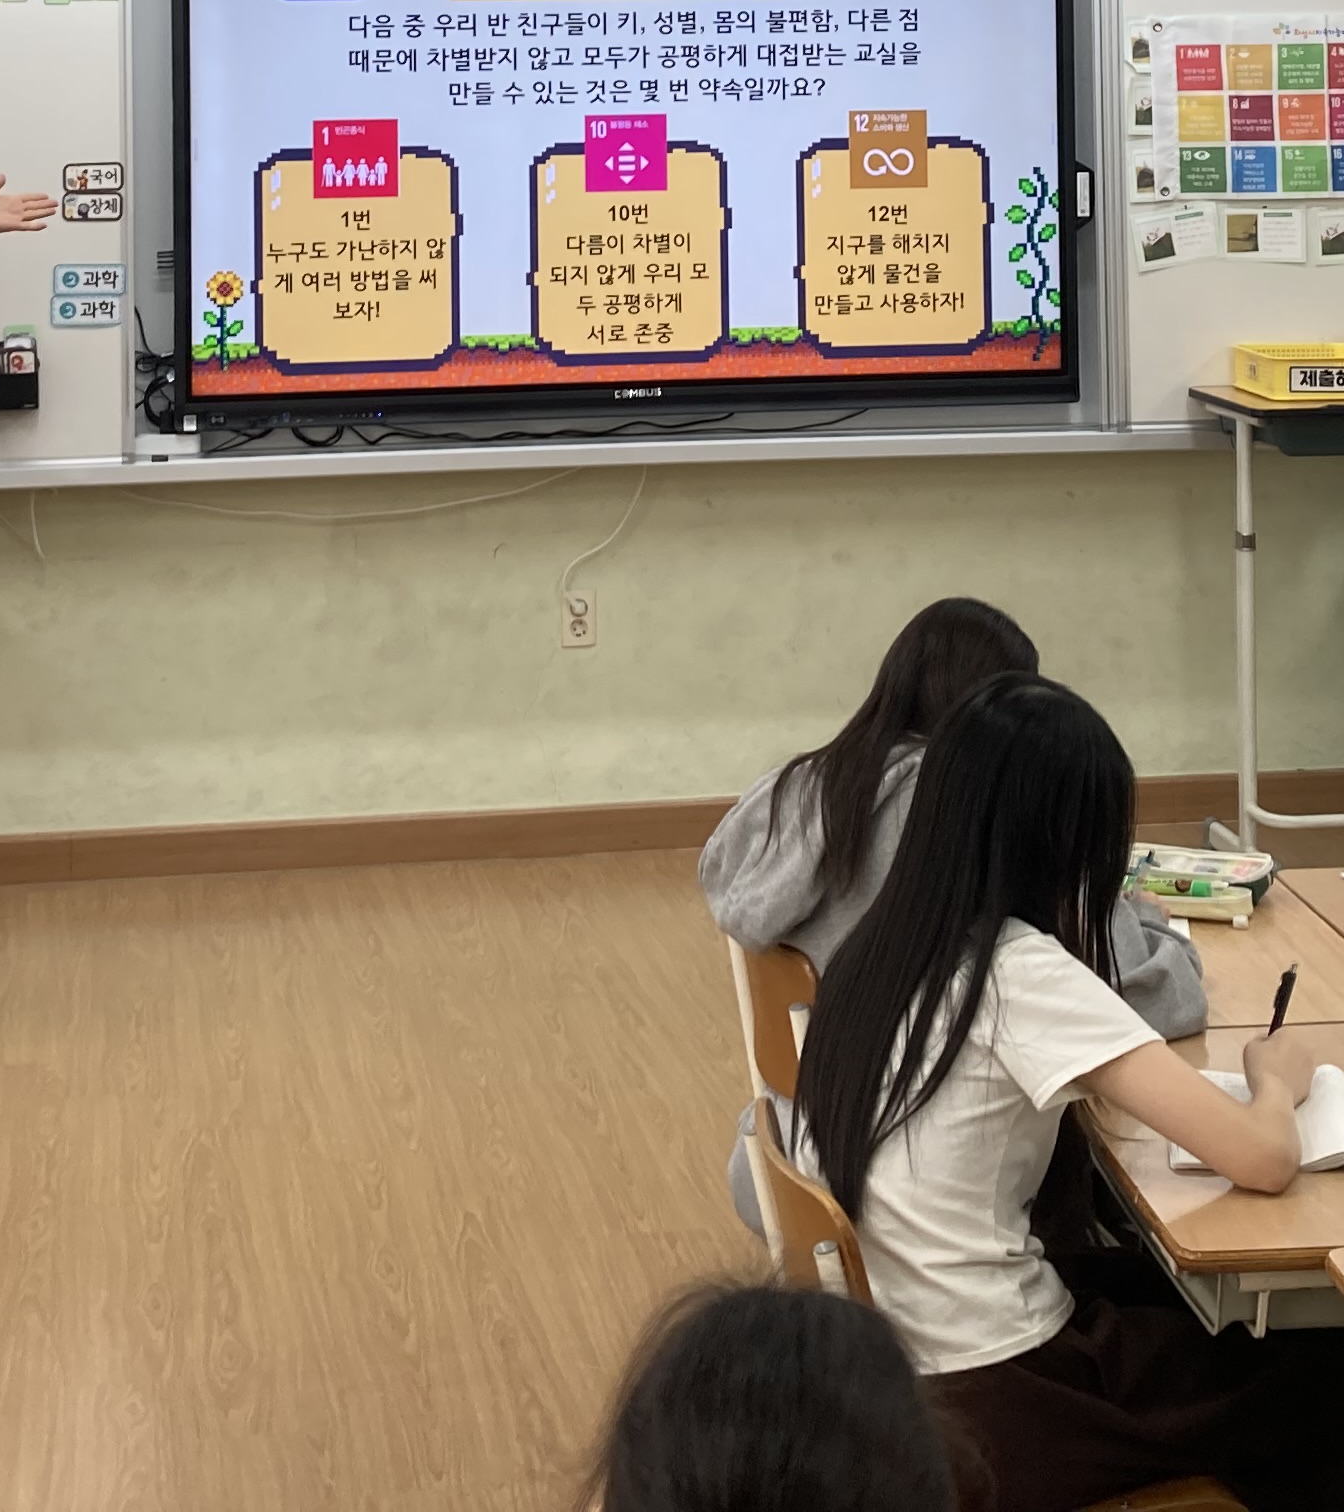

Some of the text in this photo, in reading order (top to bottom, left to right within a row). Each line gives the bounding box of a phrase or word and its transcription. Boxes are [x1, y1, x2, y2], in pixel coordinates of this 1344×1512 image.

[348, 8, 919, 38] 다음 중 우리 반 친구들이 키, 성별, 몸의 불편함, 다른 점
[348, 41, 921, 72] 때문에 차별받지 않고 모두가 공평하게 대접받는 교실을
[449, 77, 826, 106] 만들 수 있는 것은 몇 번 약속일까요?
[590, 120, 607, 139] 10
[854, 114, 869, 132] 12
[321, 126, 329, 145] 1
[90, 168, 118, 185] 국어
[341, 209, 371, 231] 1번
[608, 204, 649, 225] 10번
[868, 204, 908, 225] 12번
[266, 238, 446, 263] 누구도 가난하지 않
[566, 233, 691, 255] 다름이 차별이
[827, 233, 949, 255] 지구를 해치지
[83, 270, 119, 288] 과학
[274, 269, 437, 294] 게 여러 방법을 써
[550, 263, 709, 286] 되지 않게 우리 모
[837, 263, 942, 285] 않게 물건을
[80, 301, 116, 319] 과학
[333, 301, 380, 322] 보자!
[576, 292, 682, 316] 두 공평하게
[814, 292, 964, 316] 만들고 사용하자!
[587, 322, 674, 345] 서로 존중
